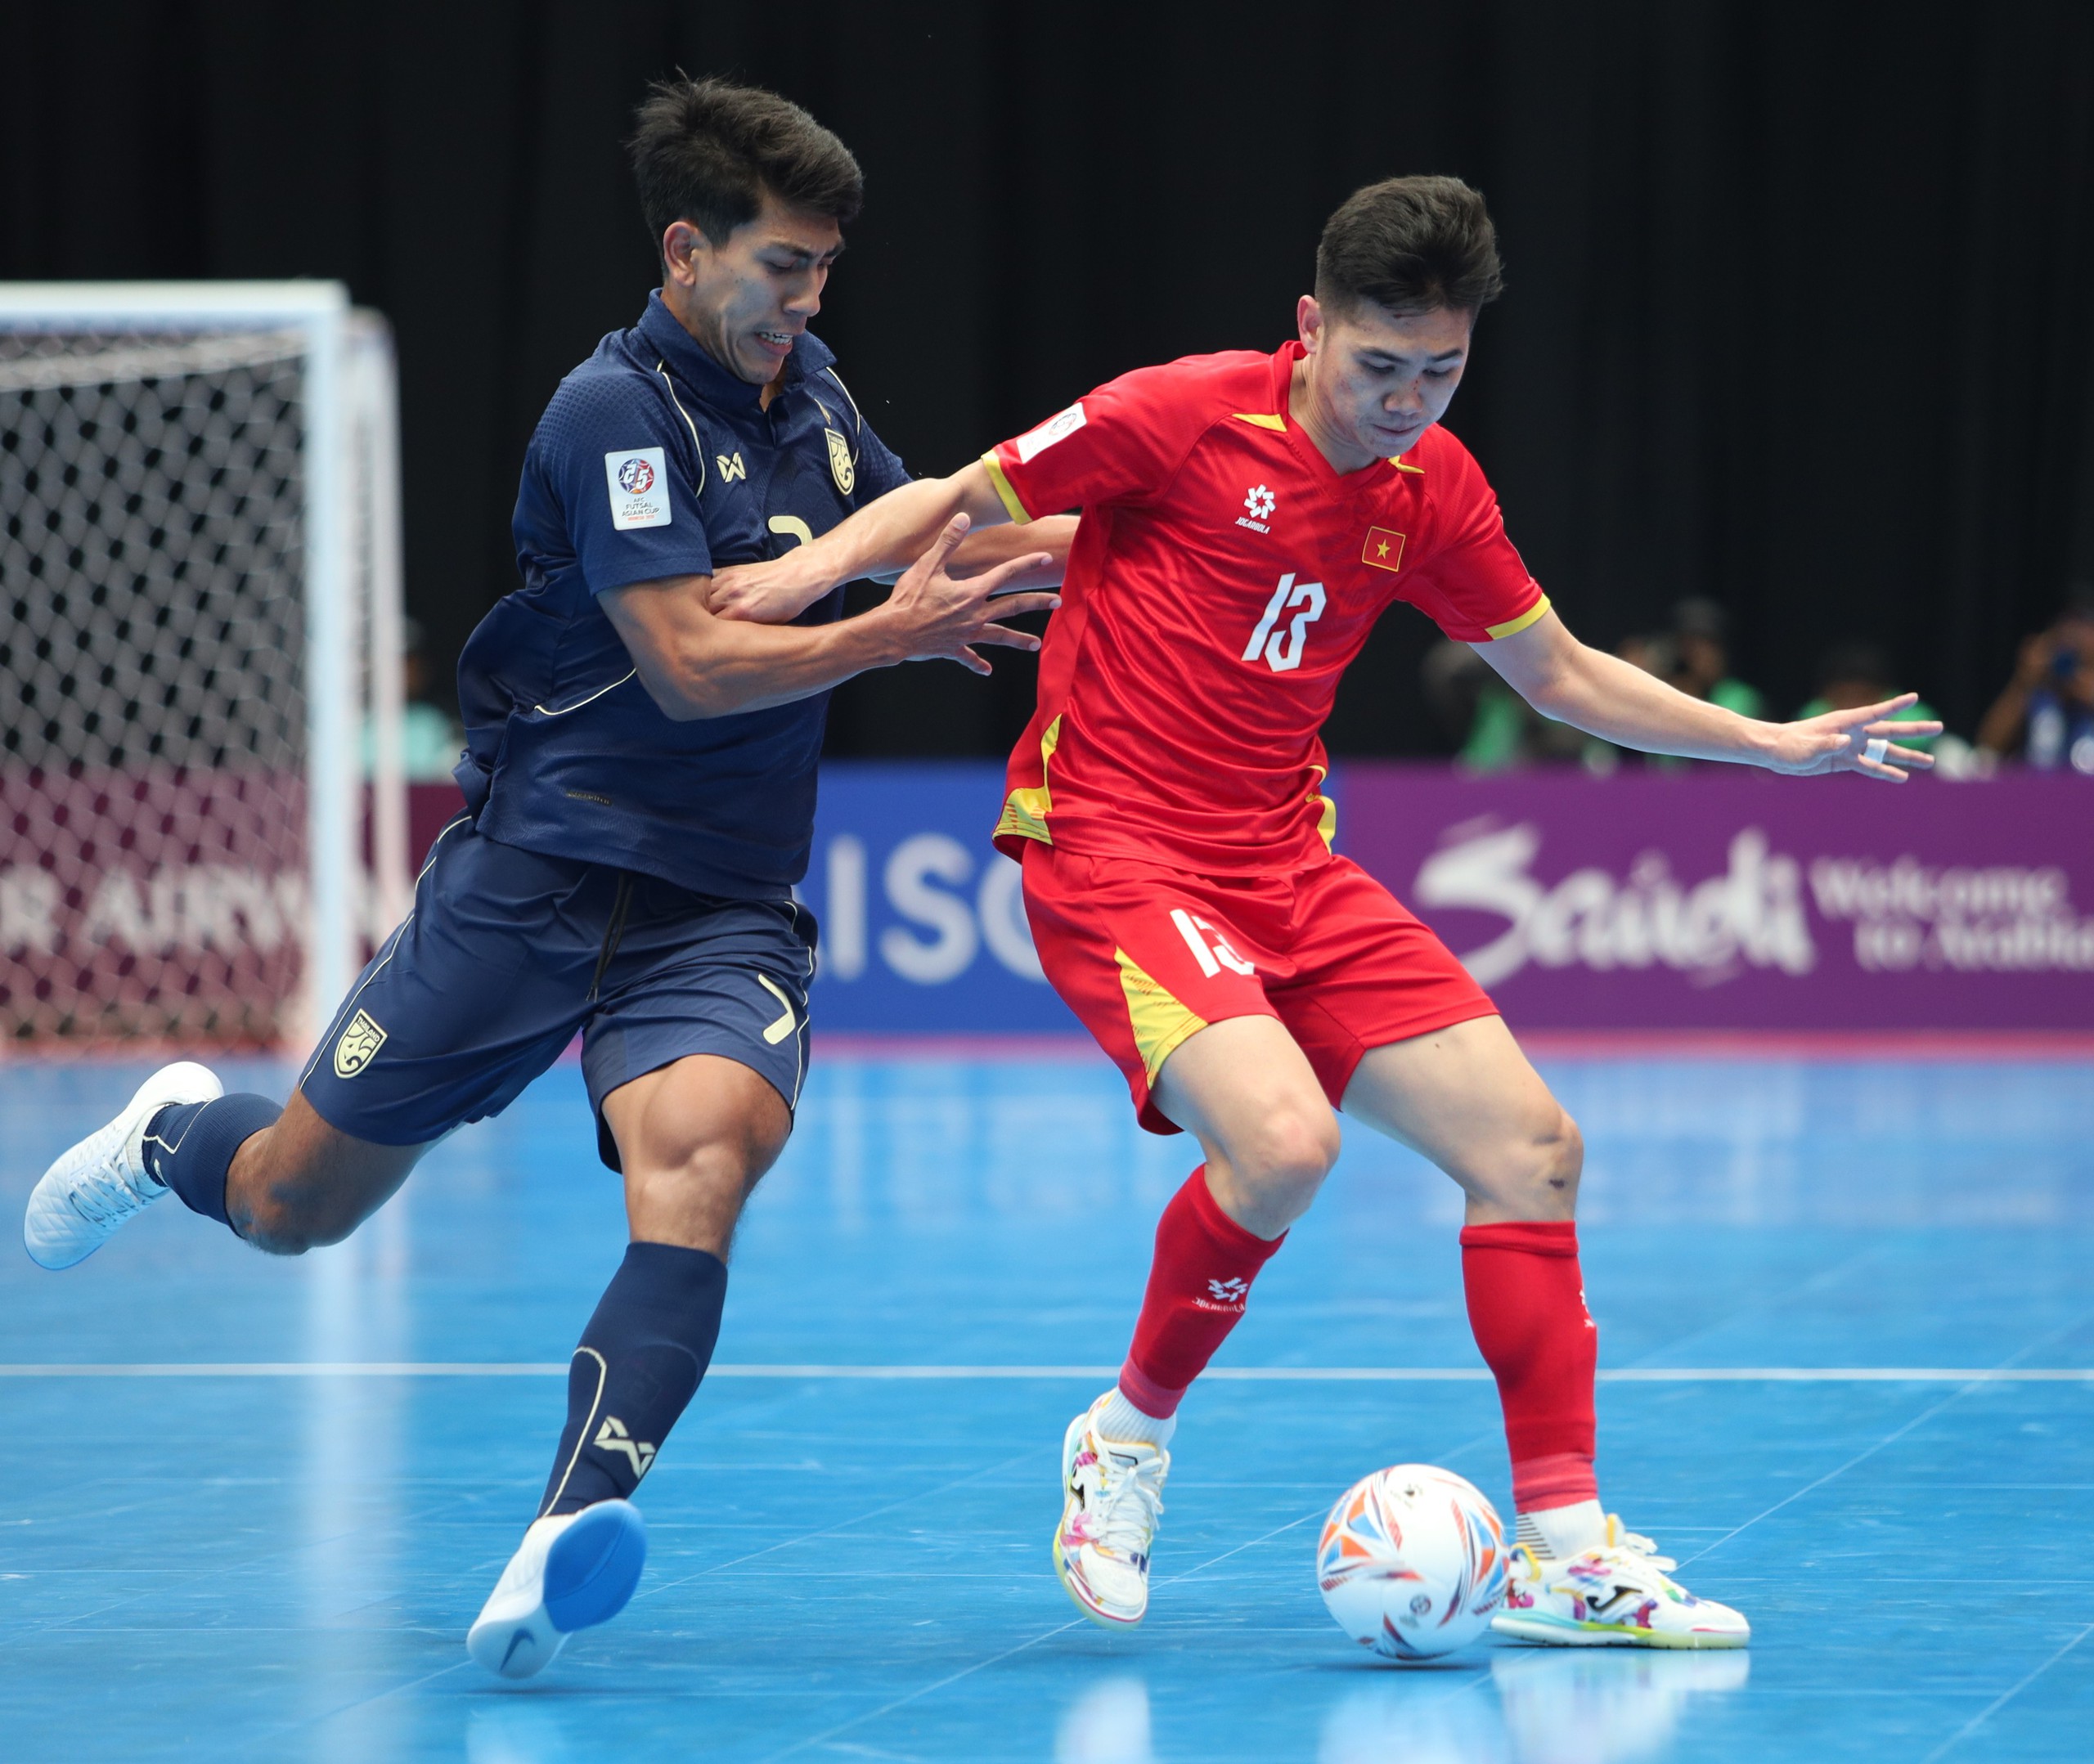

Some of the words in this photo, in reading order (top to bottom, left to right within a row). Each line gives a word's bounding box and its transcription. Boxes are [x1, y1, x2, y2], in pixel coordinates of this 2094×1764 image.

[622, 509, 644, 517] ASIAN
[645, 507, 660, 515] CUP
[1234, 516, 1270, 535] JOGARBOLA
[1241, 572, 1327, 673] 13
[1414, 820, 1816, 990] Saudi
[357, 1016, 380, 1043] THAILAND
